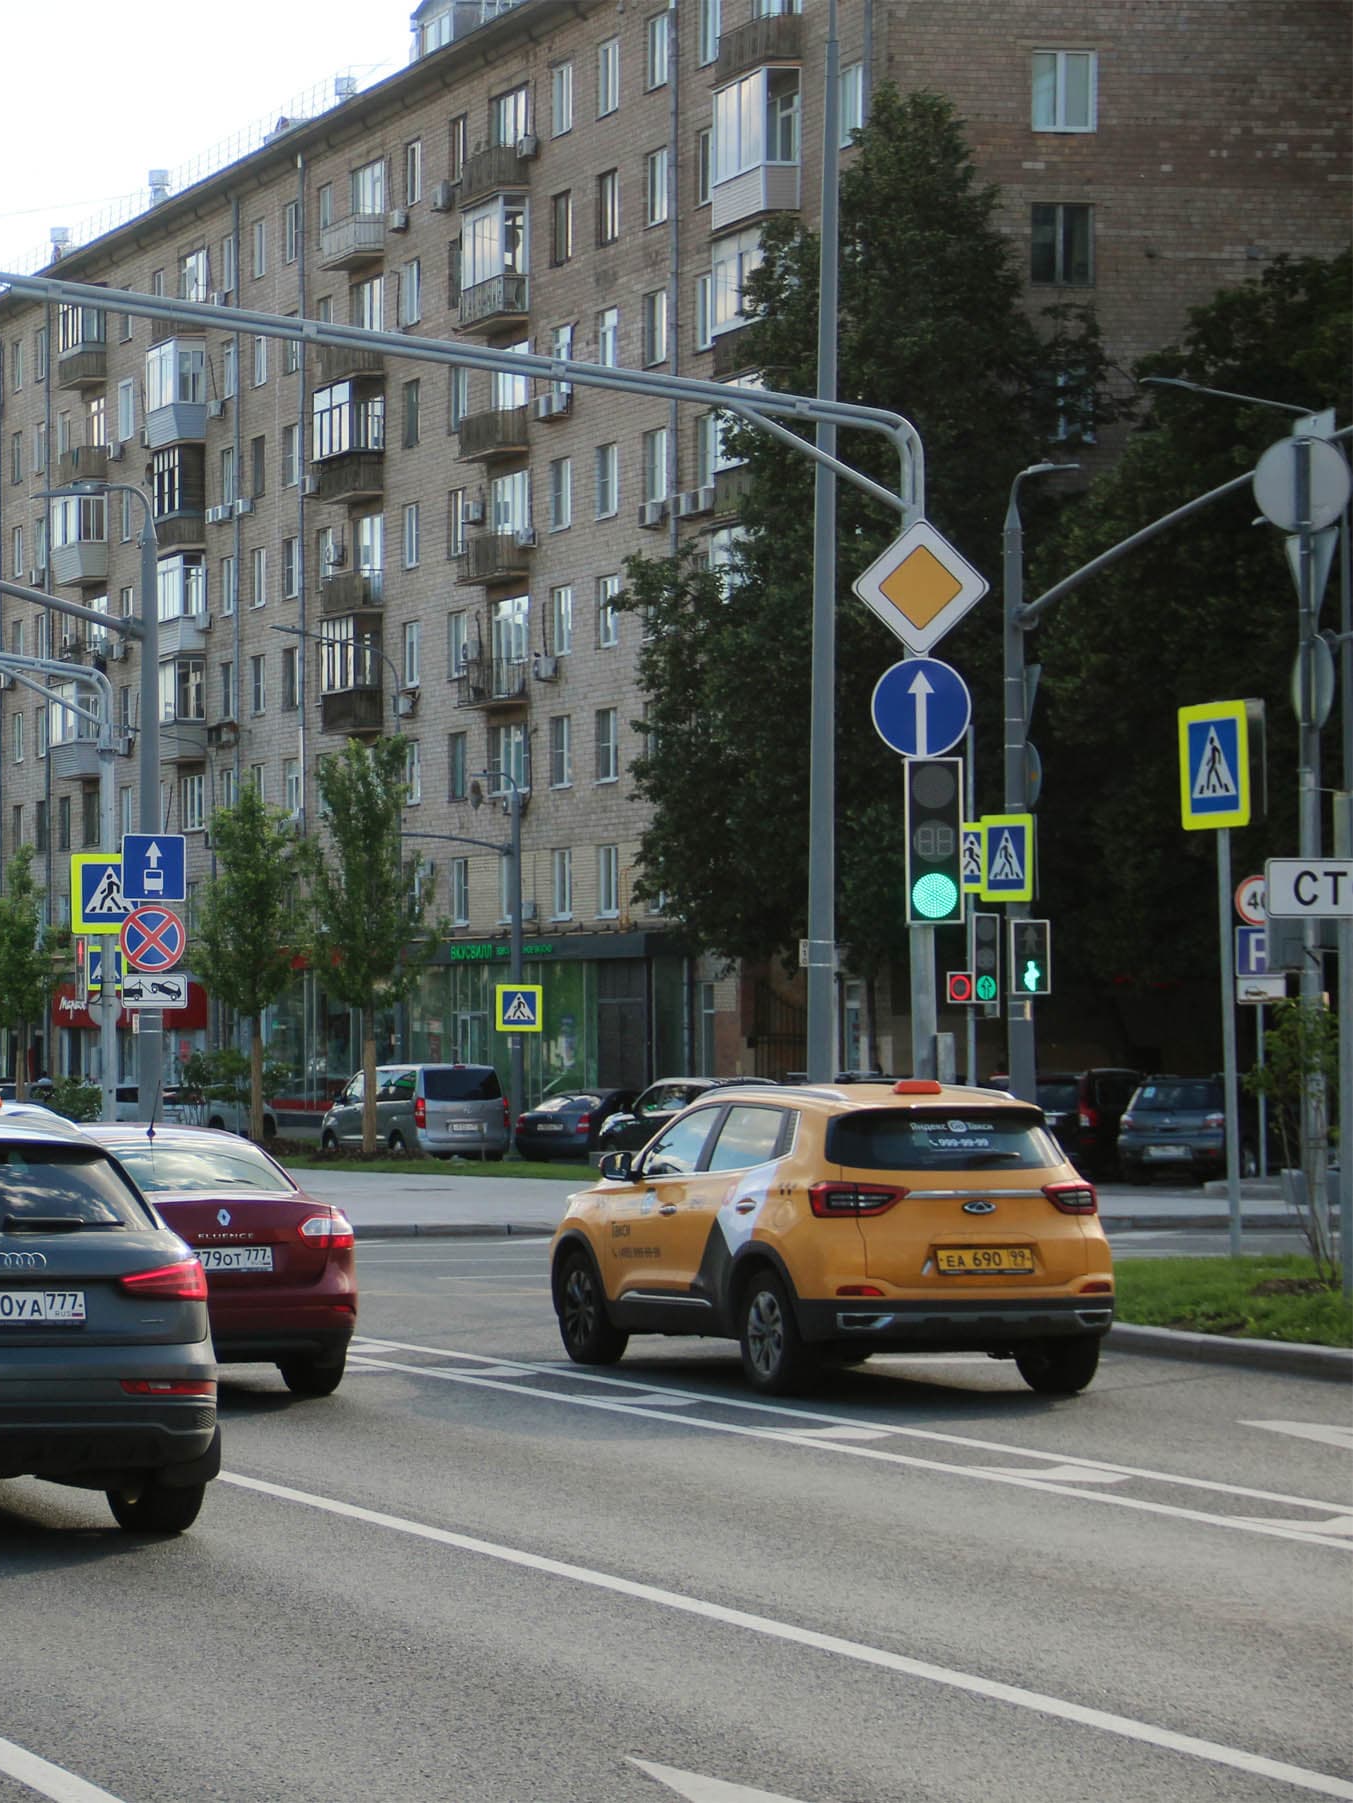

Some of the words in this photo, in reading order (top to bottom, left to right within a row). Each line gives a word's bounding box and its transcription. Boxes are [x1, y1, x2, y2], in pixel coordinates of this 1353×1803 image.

[1294, 870, 1353, 906] СТ
[245, 1248, 267, 1261] 777
[972, 1252, 1002, 1267] 690
[46, 1293, 78, 1310] 777
